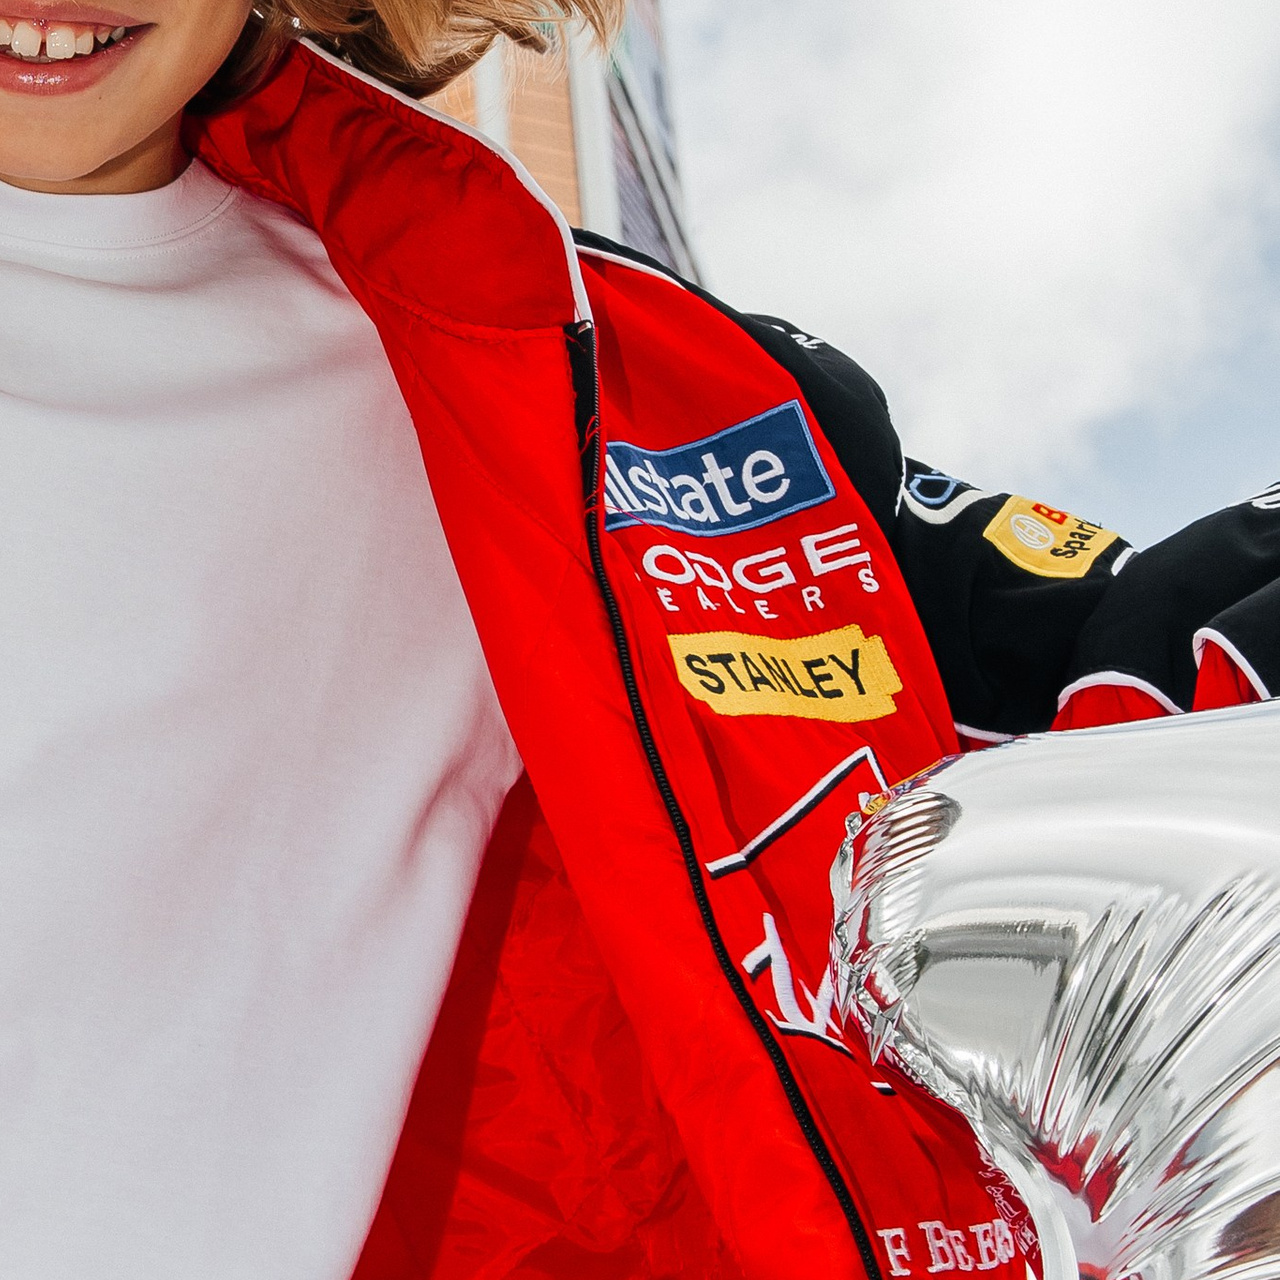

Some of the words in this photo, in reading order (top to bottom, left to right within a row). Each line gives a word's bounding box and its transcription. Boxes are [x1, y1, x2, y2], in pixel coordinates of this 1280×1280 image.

[641, 522, 872, 594] ODGE
[656, 568, 880, 620] EALERS
[685, 647, 867, 700] STANLEY
